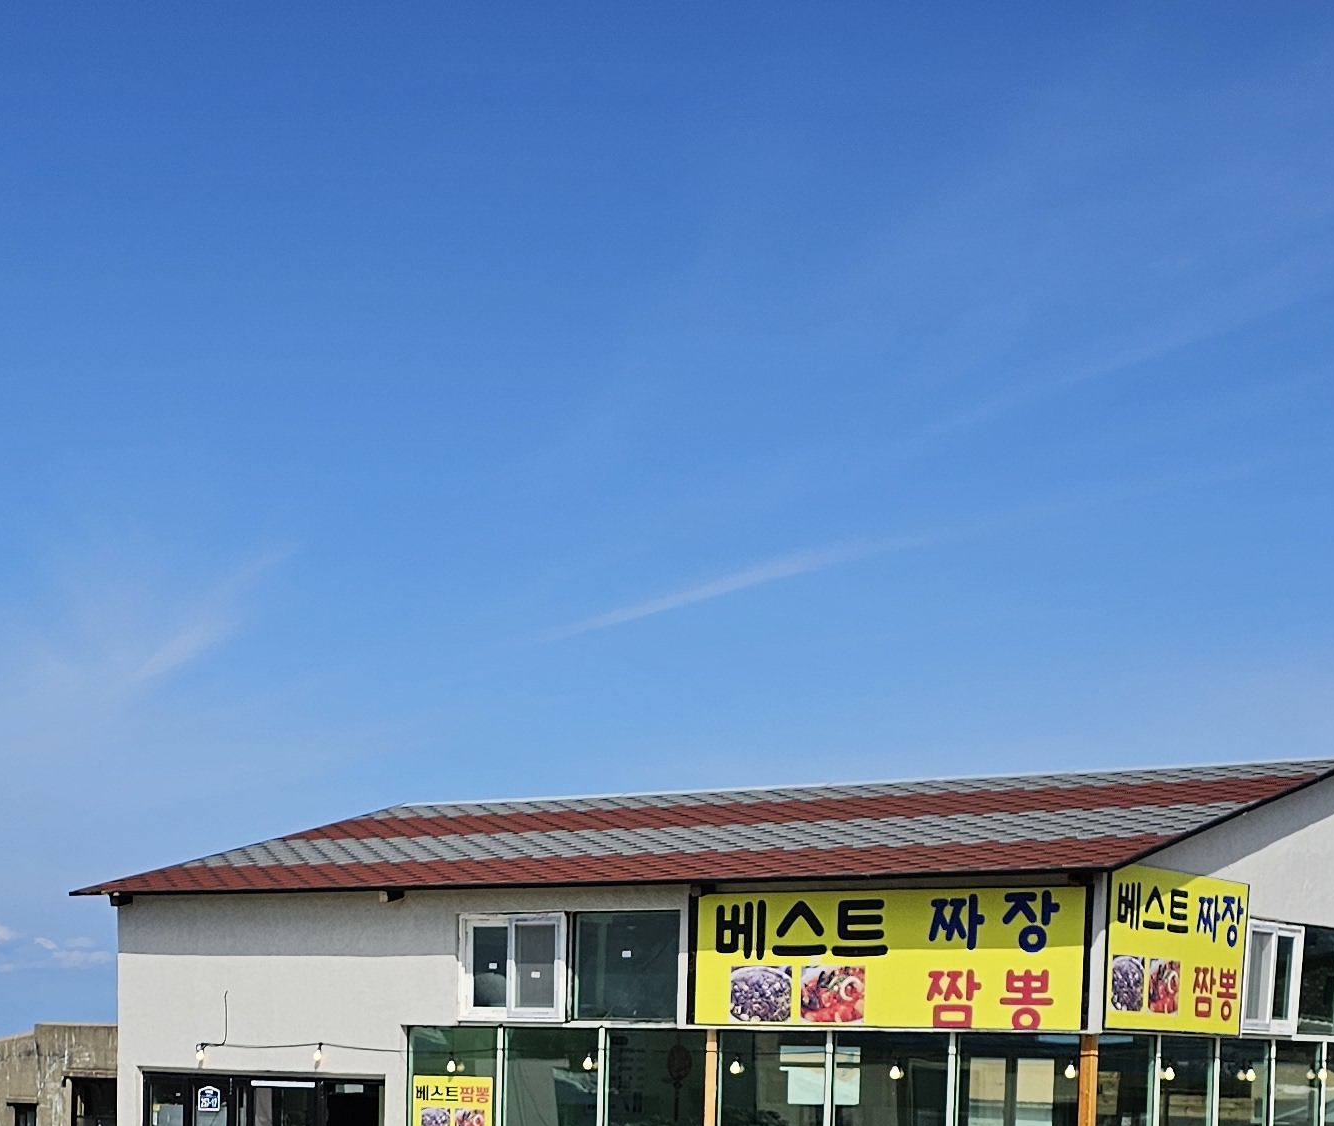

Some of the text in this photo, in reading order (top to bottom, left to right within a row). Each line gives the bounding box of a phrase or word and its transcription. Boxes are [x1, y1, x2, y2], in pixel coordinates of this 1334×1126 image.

[715, 891, 1060, 961] 베스트 짜장
[1115, 881, 1244, 948] 베스트 짜장
[926, 968, 1055, 1029] 짬뽕
[1192, 966, 1239, 1022] 짬뽕
